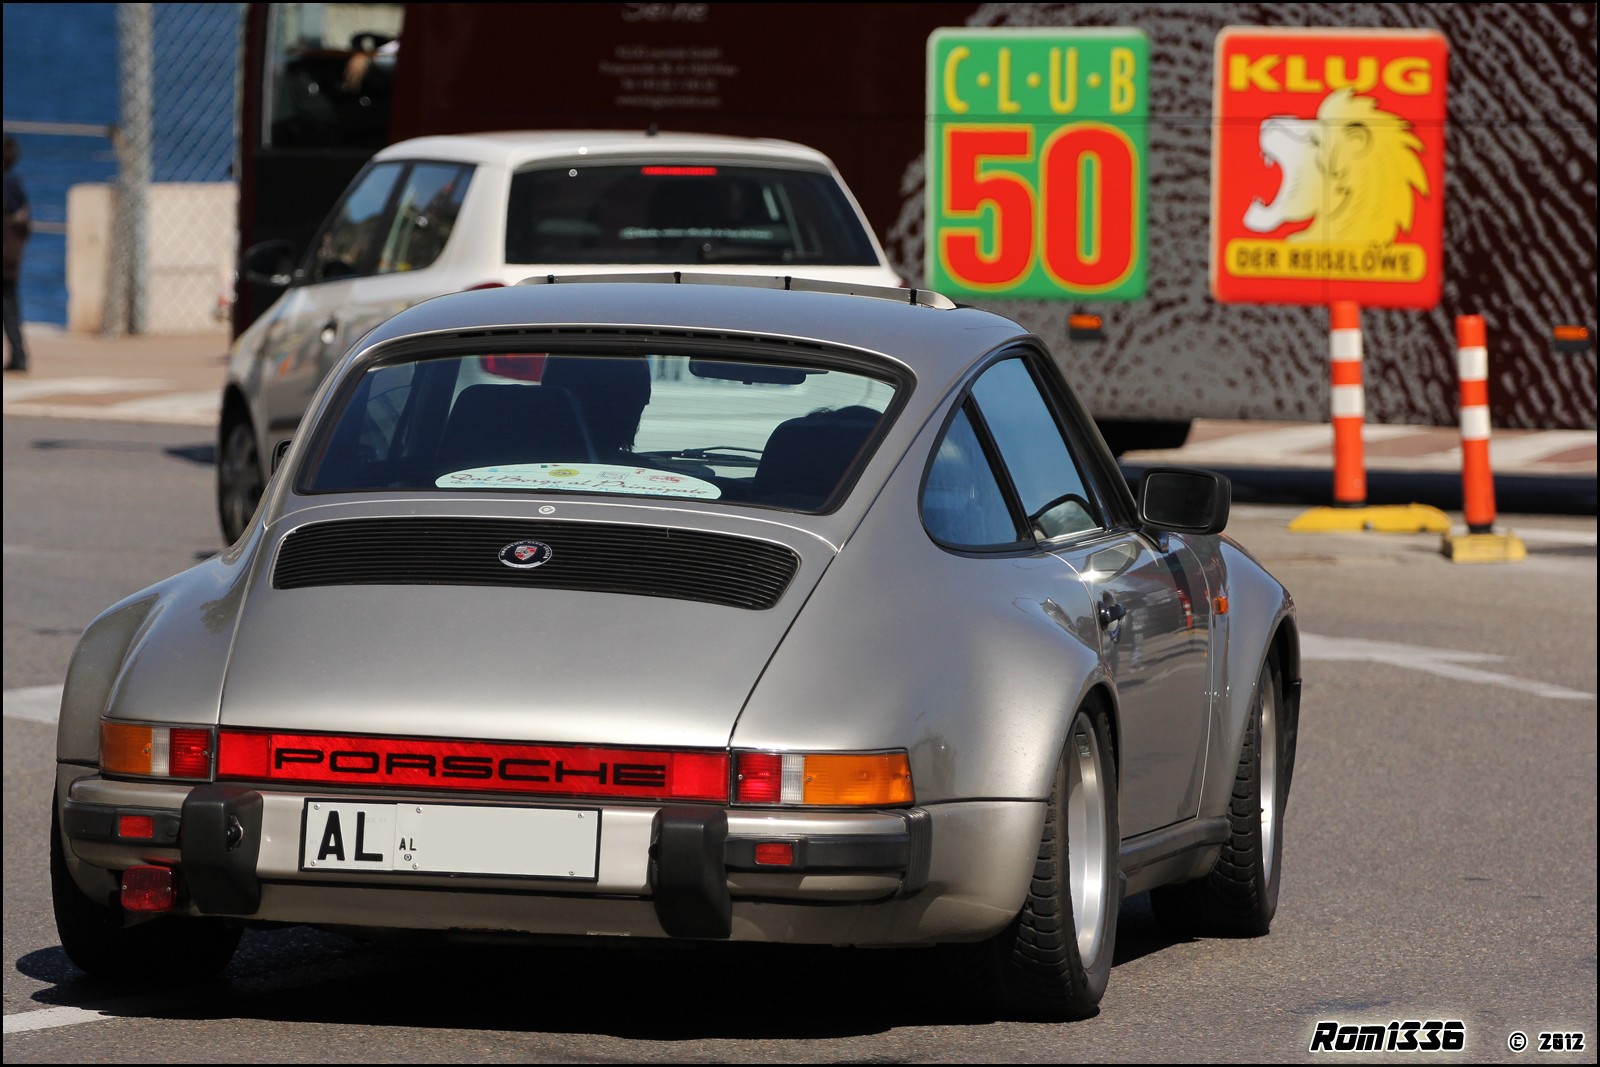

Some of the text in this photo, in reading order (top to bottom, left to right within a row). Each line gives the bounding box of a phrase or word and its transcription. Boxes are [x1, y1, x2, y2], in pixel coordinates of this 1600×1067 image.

[1228, 54, 1432, 95] KLUG
[938, 120, 1140, 294] 50
[1236, 247, 1279, 268] DER
[275, 748, 666, 788] PORSCHE
[317, 810, 384, 862] AL
[399, 837, 417, 851] AL
